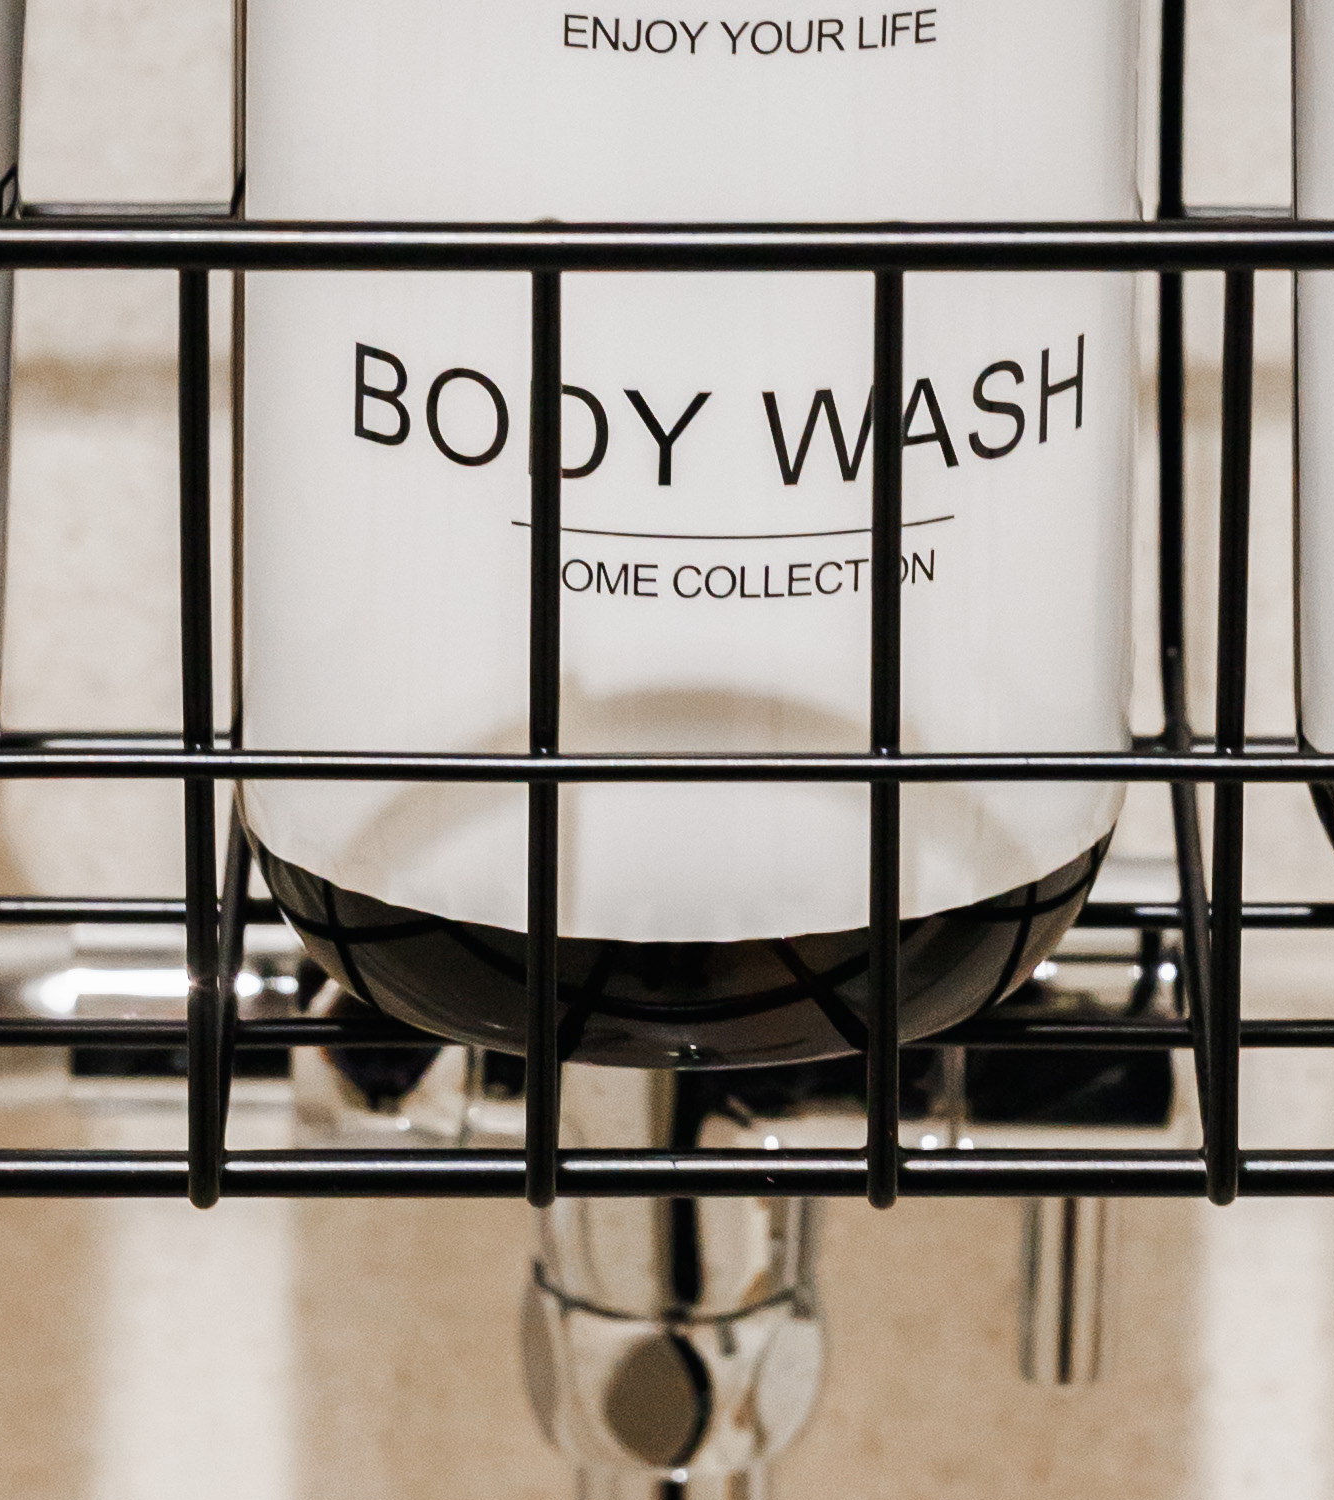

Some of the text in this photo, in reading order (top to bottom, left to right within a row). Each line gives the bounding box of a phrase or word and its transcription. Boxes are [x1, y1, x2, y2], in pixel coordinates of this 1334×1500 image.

[564, 8, 937, 55] ENJOY YOUR LIFE
[354, 333, 1085, 487] BODY WASH
[560, 549, 935, 599] OME COLLECTN
